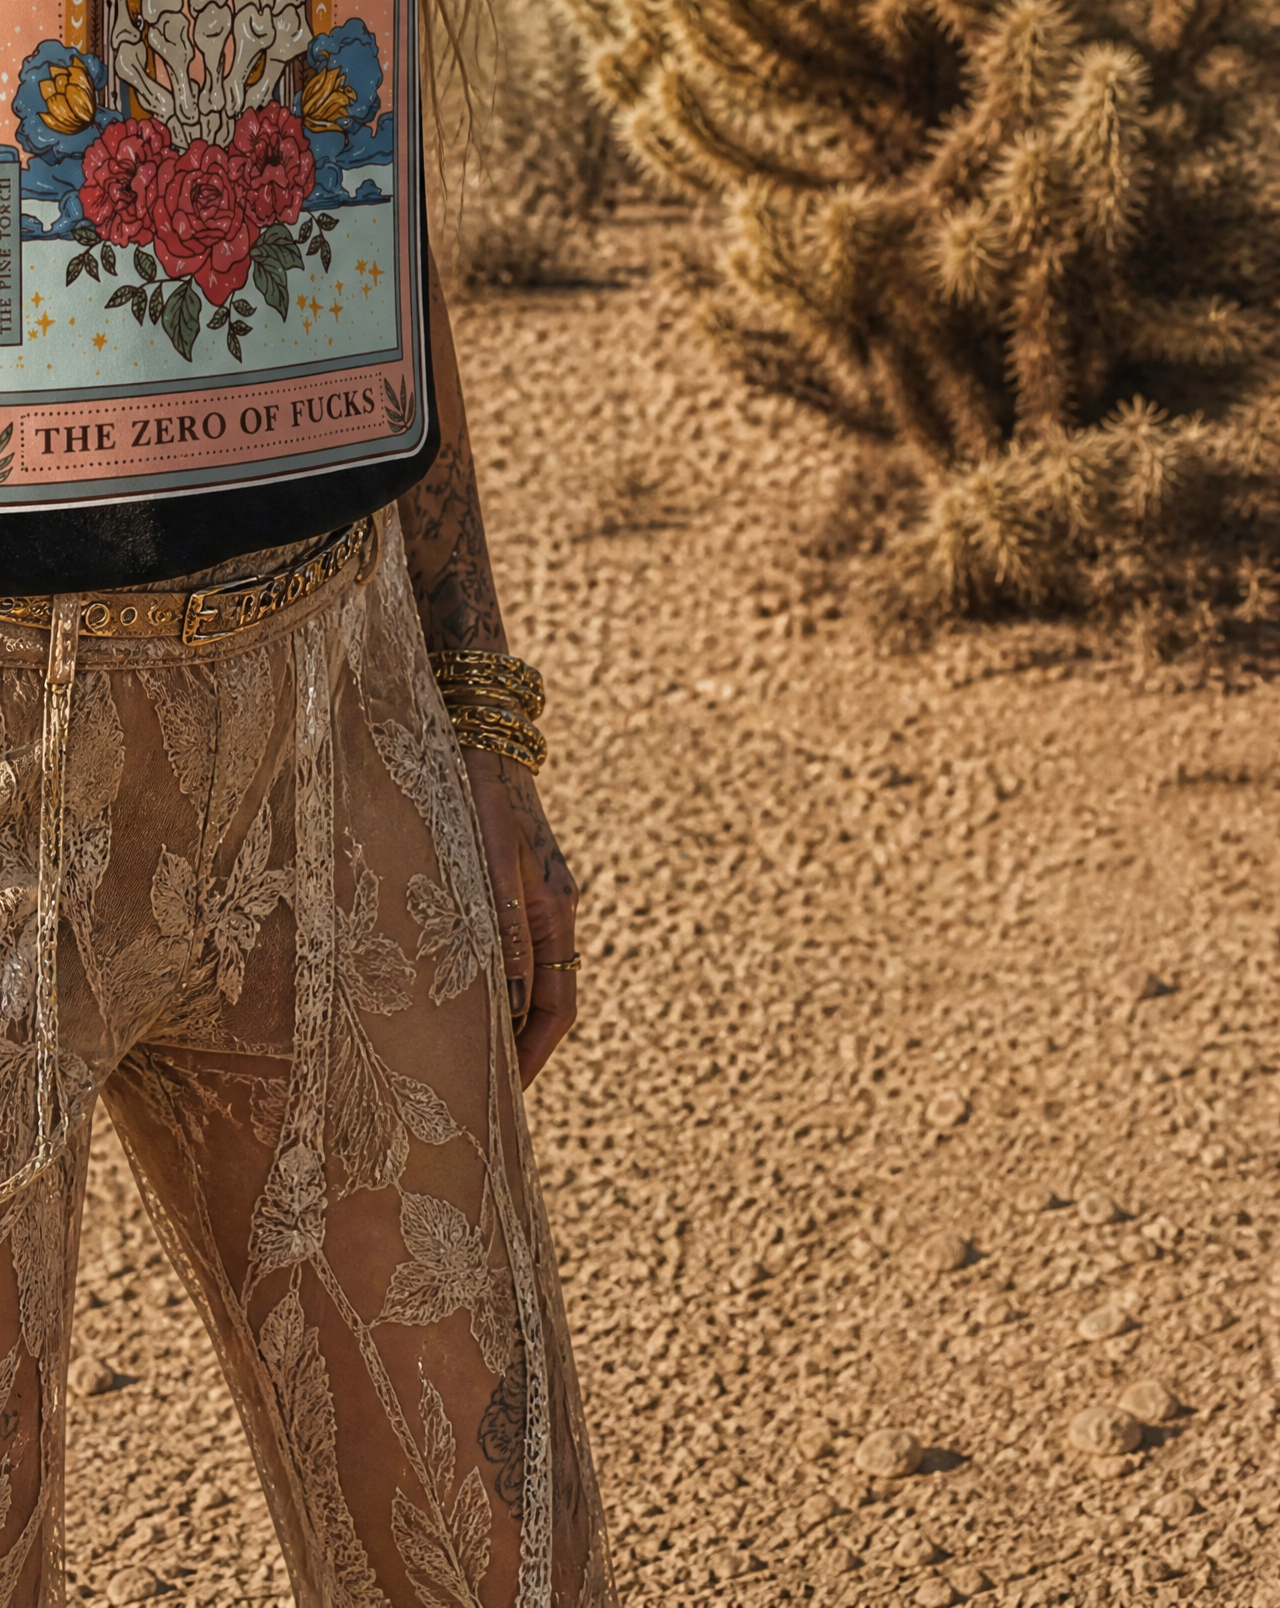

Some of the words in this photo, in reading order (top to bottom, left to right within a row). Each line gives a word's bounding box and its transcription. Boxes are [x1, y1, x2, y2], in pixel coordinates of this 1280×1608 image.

[0, 297, 12, 335] THE
[35, 423, 117, 455] THE
[131, 411, 227, 448] ZERO
[239, 404, 281, 435] OF
[291, 387, 376, 428] FUCKS
